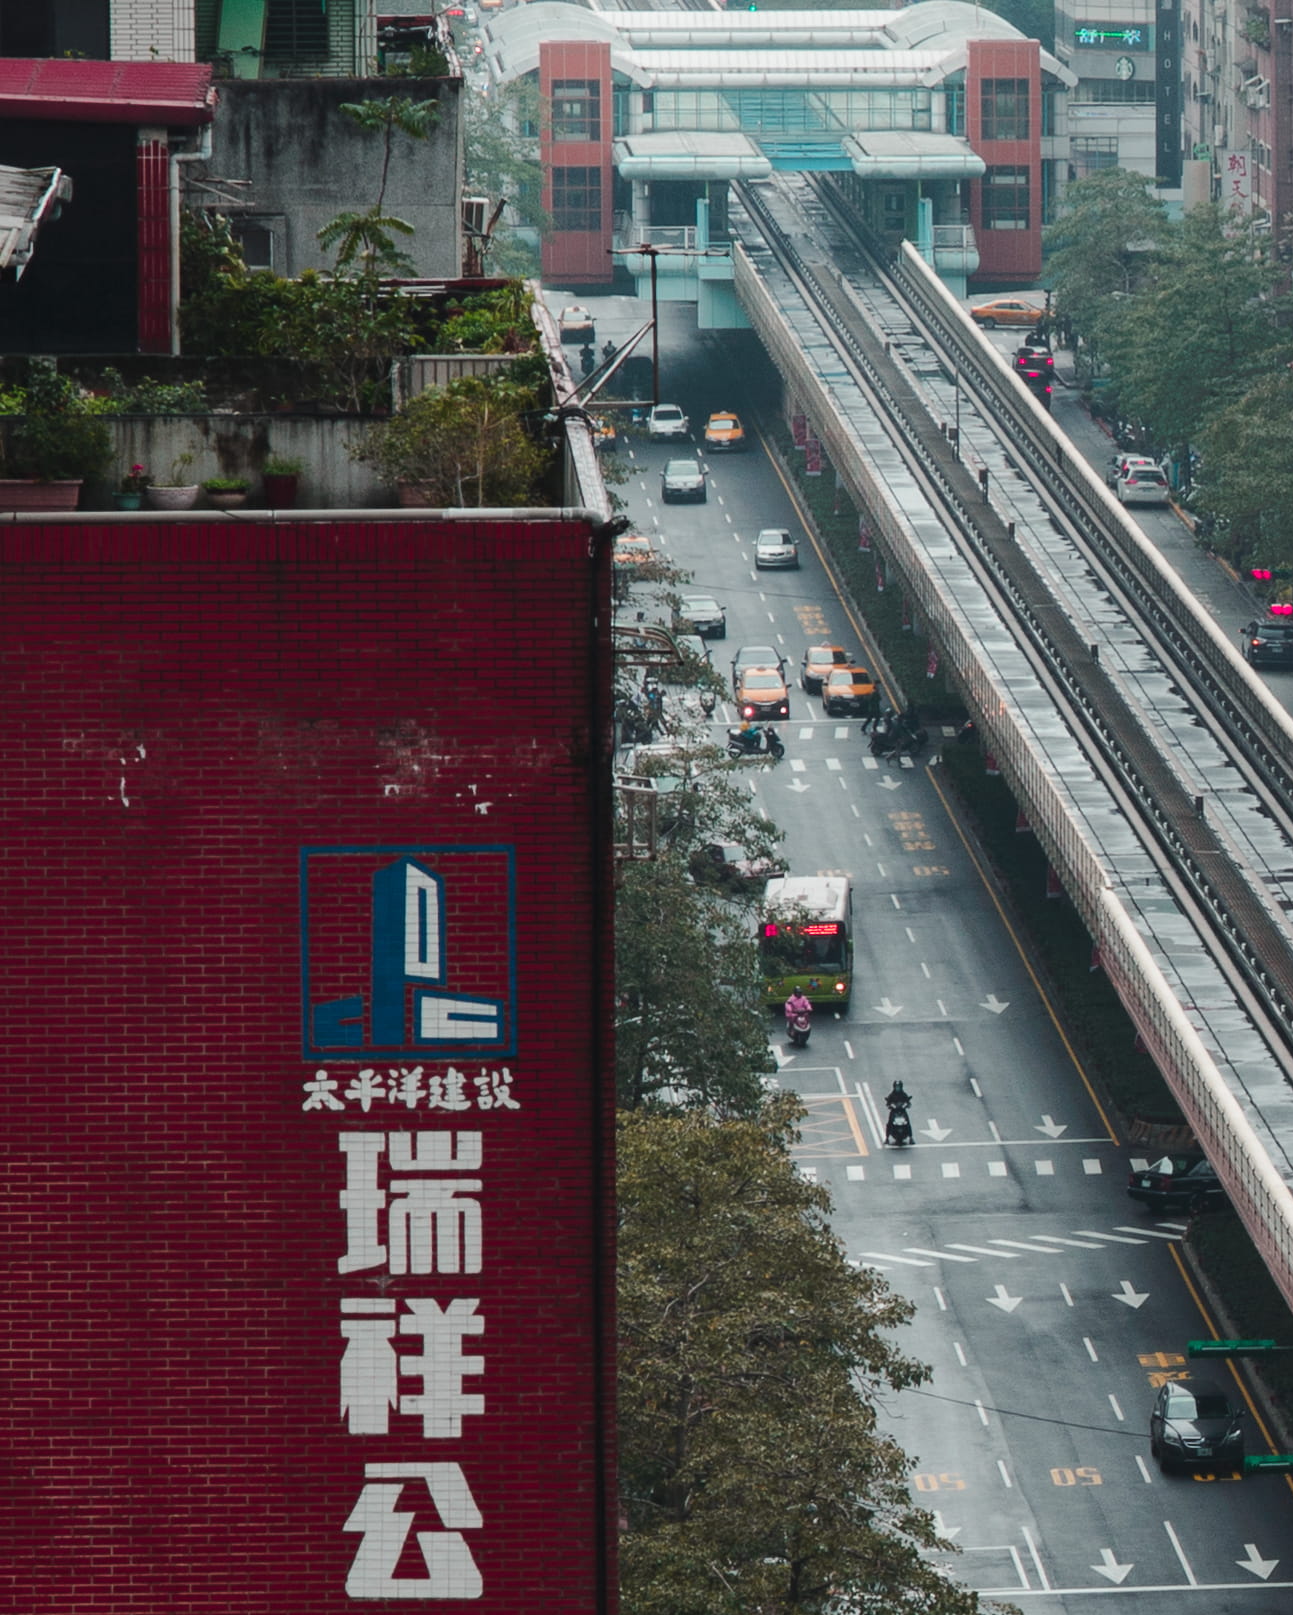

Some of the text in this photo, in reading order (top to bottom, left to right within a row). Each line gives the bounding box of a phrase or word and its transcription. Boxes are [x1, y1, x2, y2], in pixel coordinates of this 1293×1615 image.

[301, 1066, 520, 1113] 太平洋建設
